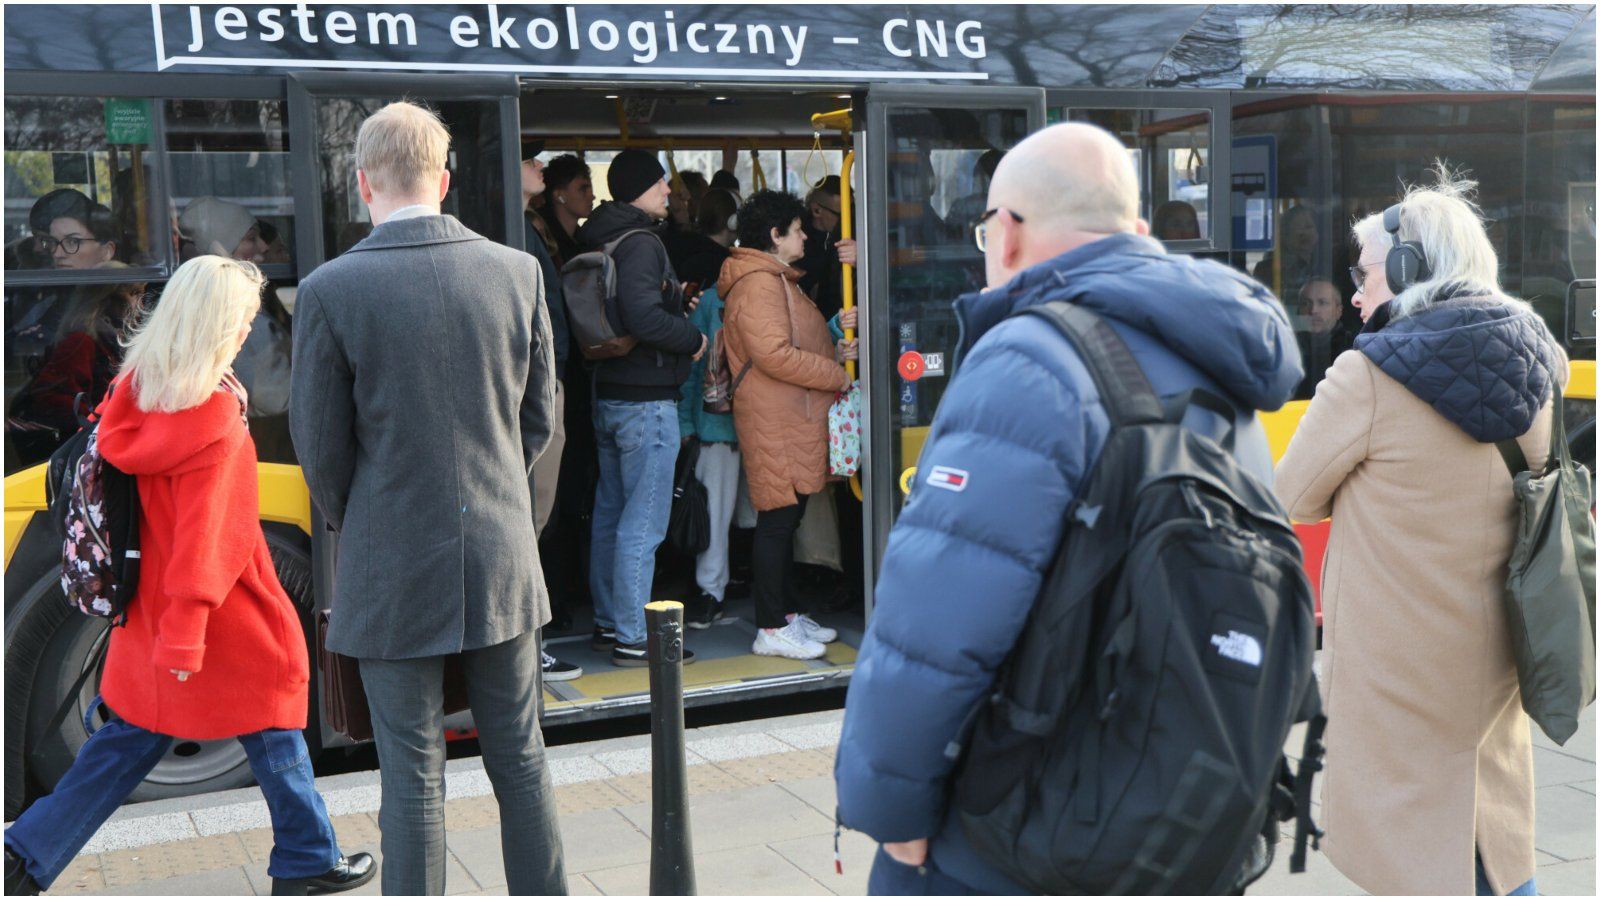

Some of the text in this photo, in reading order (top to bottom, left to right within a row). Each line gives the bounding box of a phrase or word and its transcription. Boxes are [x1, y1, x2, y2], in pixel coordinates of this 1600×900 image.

[187, 4, 418, 53] jestem
[449, 4, 809, 67] ekologiczny
[882, 18, 987, 59] CNG
